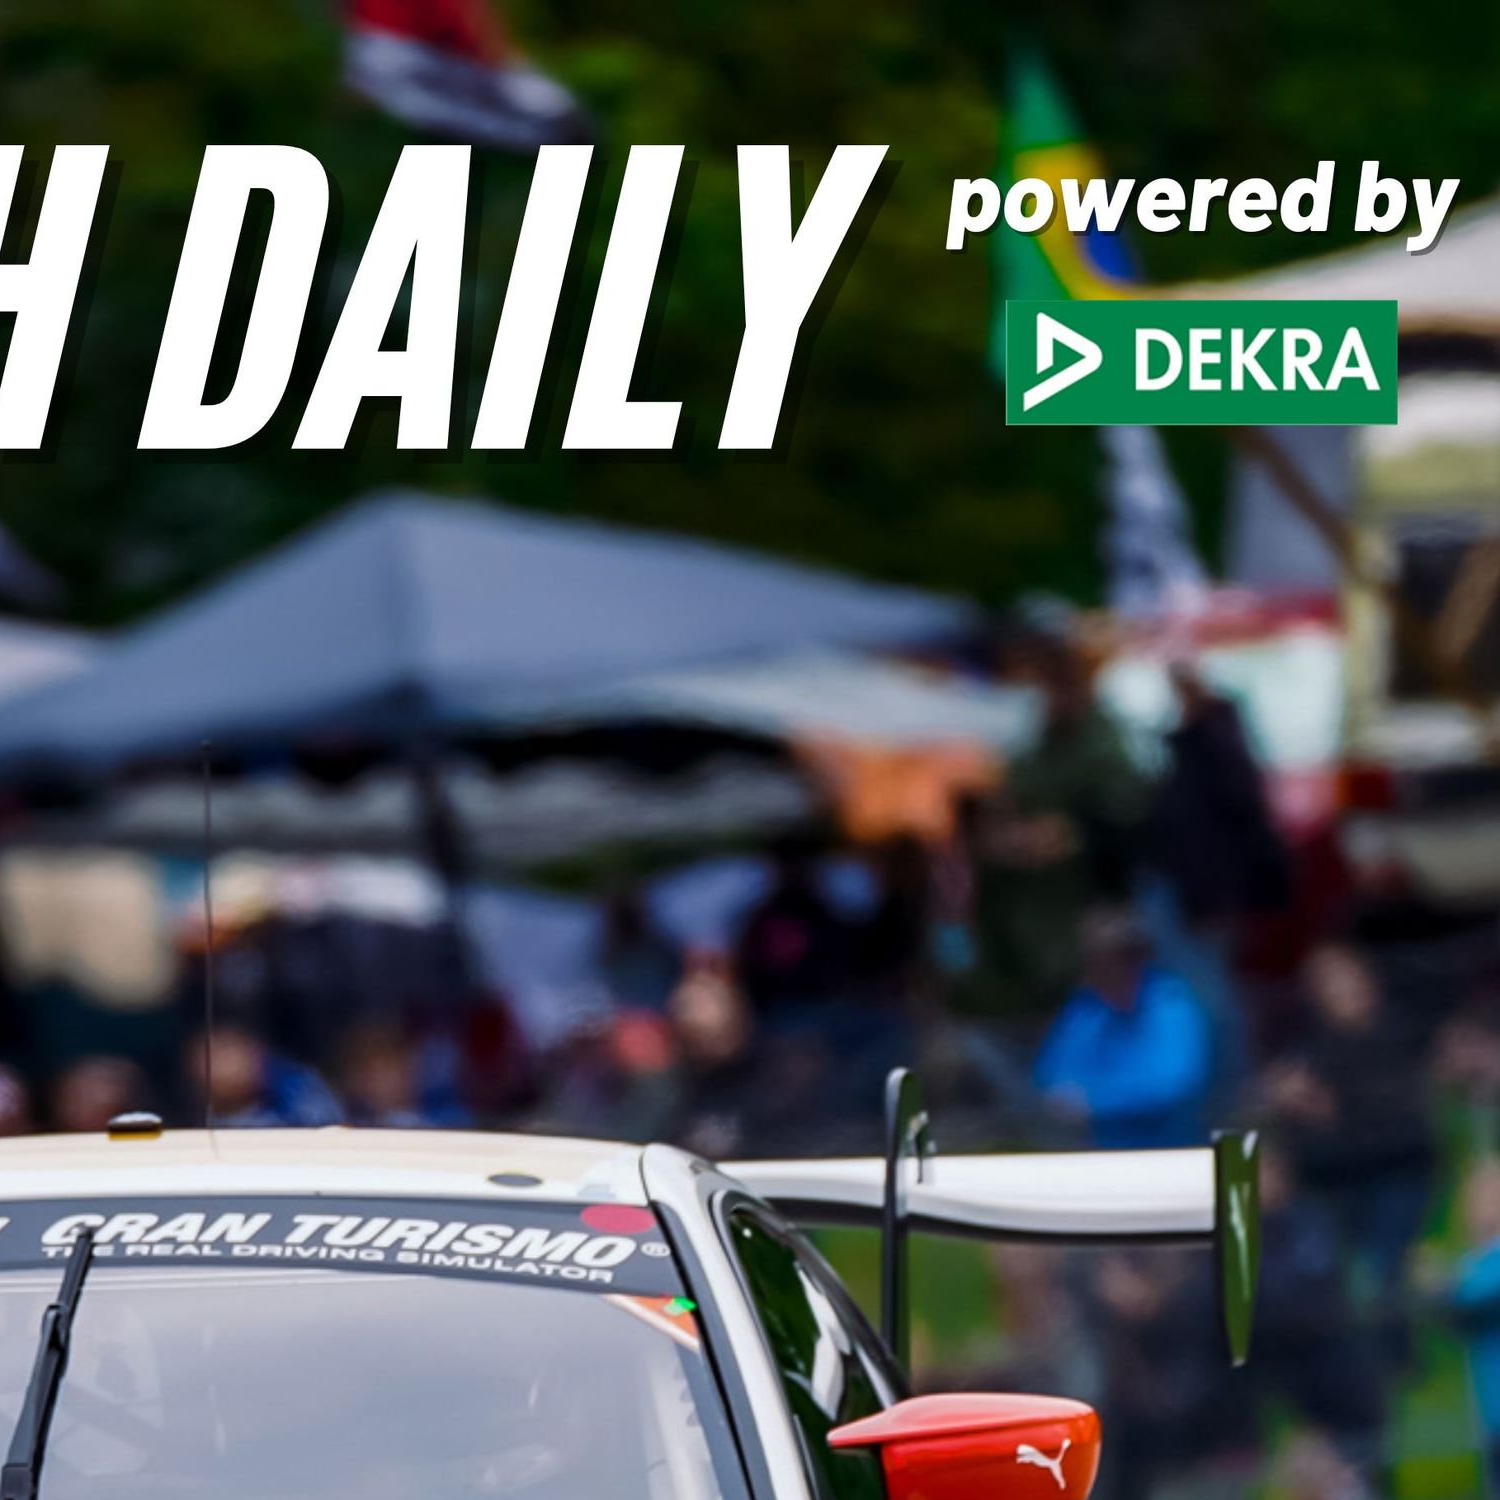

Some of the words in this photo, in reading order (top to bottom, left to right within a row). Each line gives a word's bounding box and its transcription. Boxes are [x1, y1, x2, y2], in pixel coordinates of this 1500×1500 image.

[41, 1212, 272, 1245] GRAN
[125, 1243, 221, 1256] REAL
[231, 1244, 385, 1262] DRIVING
[396, 1249, 614, 1283] SIMULATOR
